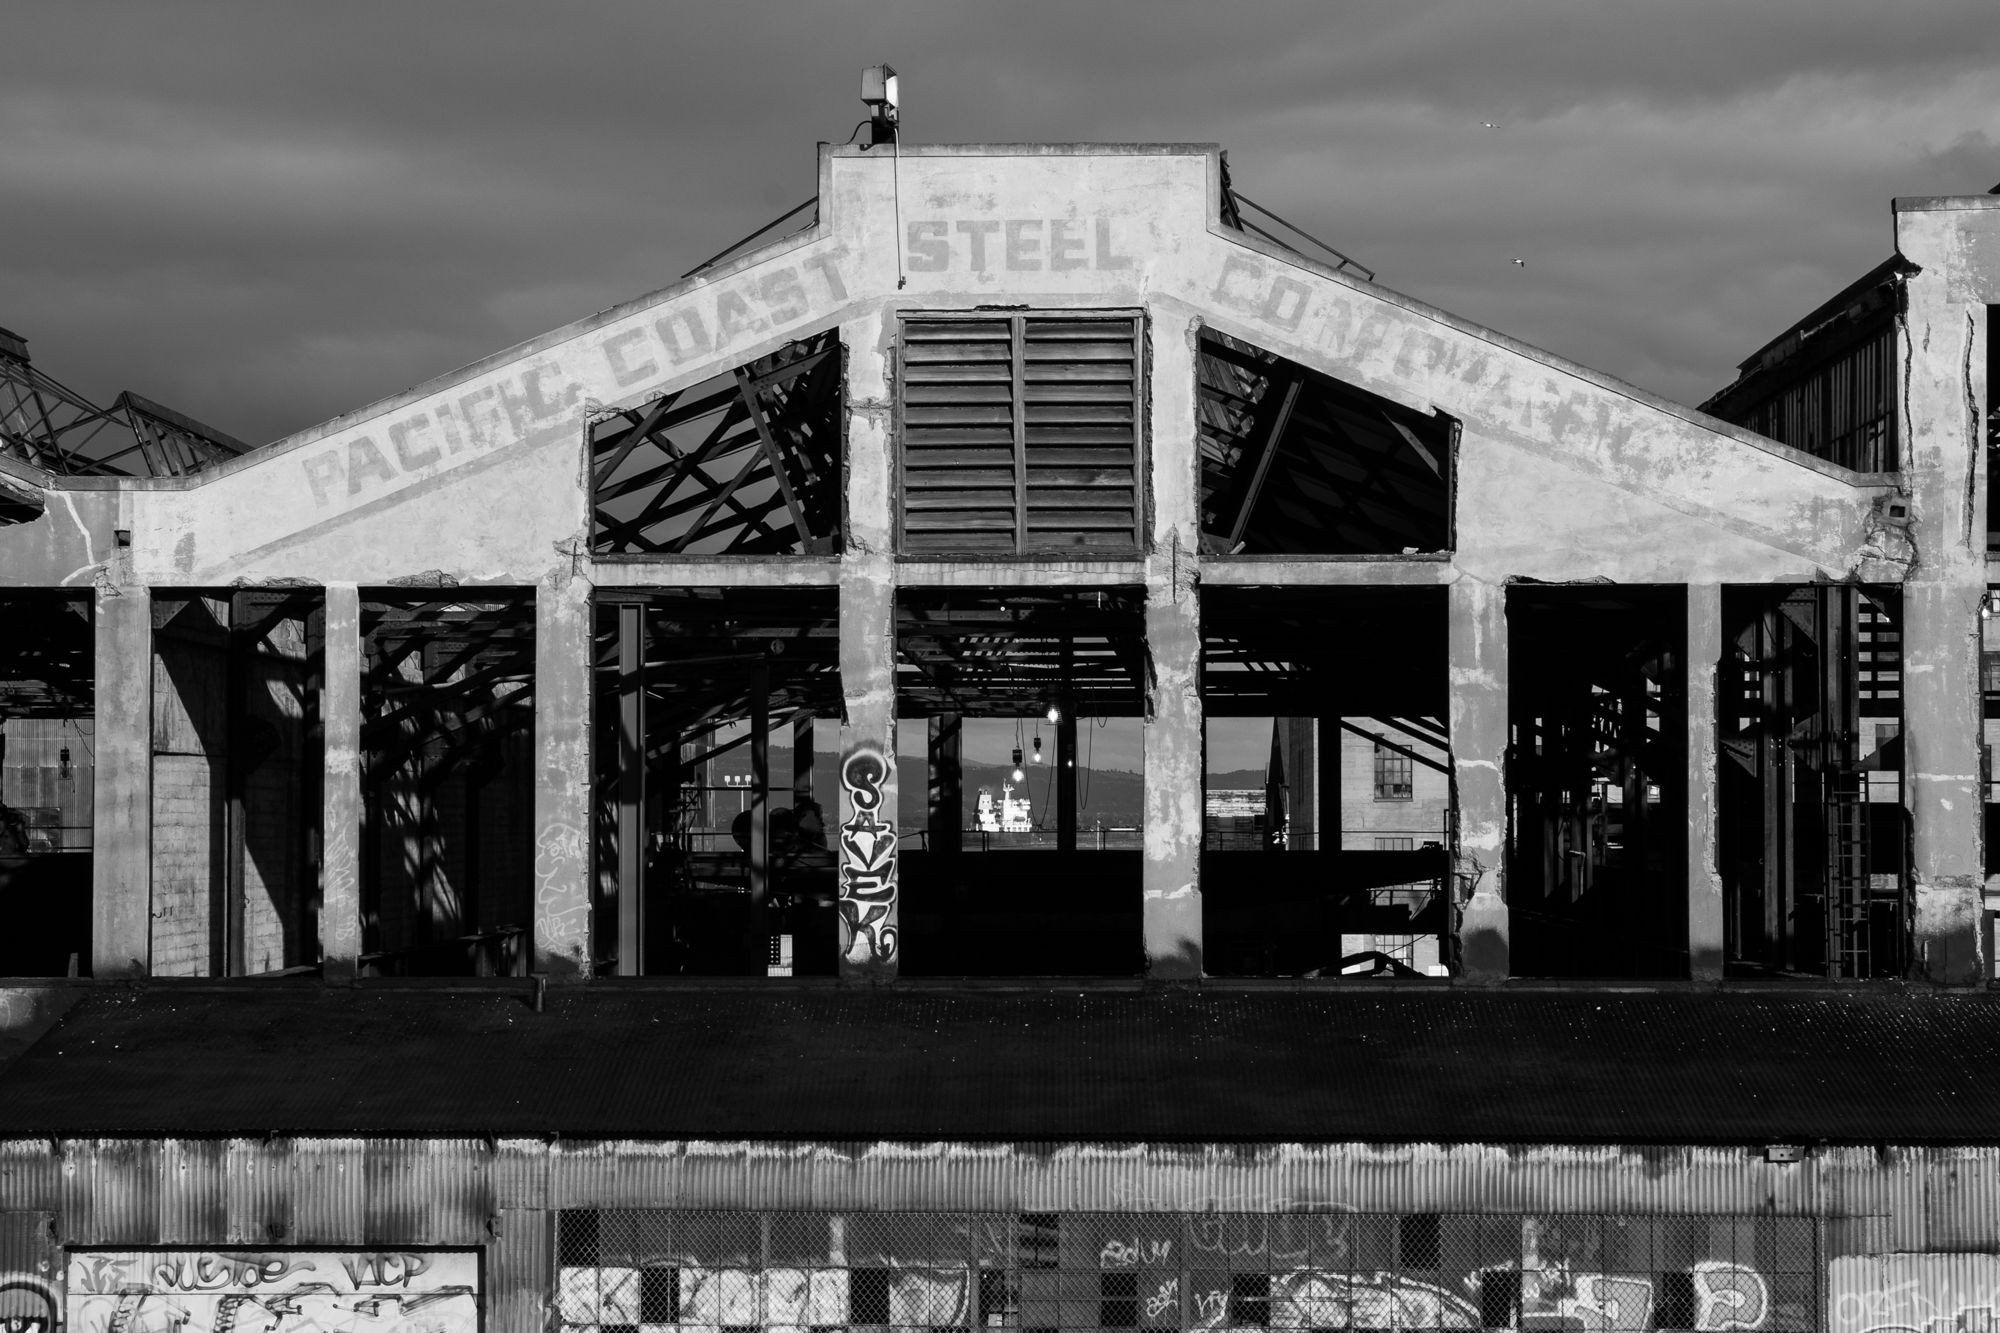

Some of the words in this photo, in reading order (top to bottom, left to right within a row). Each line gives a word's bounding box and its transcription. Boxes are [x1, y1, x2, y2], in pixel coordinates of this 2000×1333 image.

[301, 360, 584, 509] PACIFIC
[601, 243, 853, 389] COAST
[906, 218, 1134, 273] STEEL
